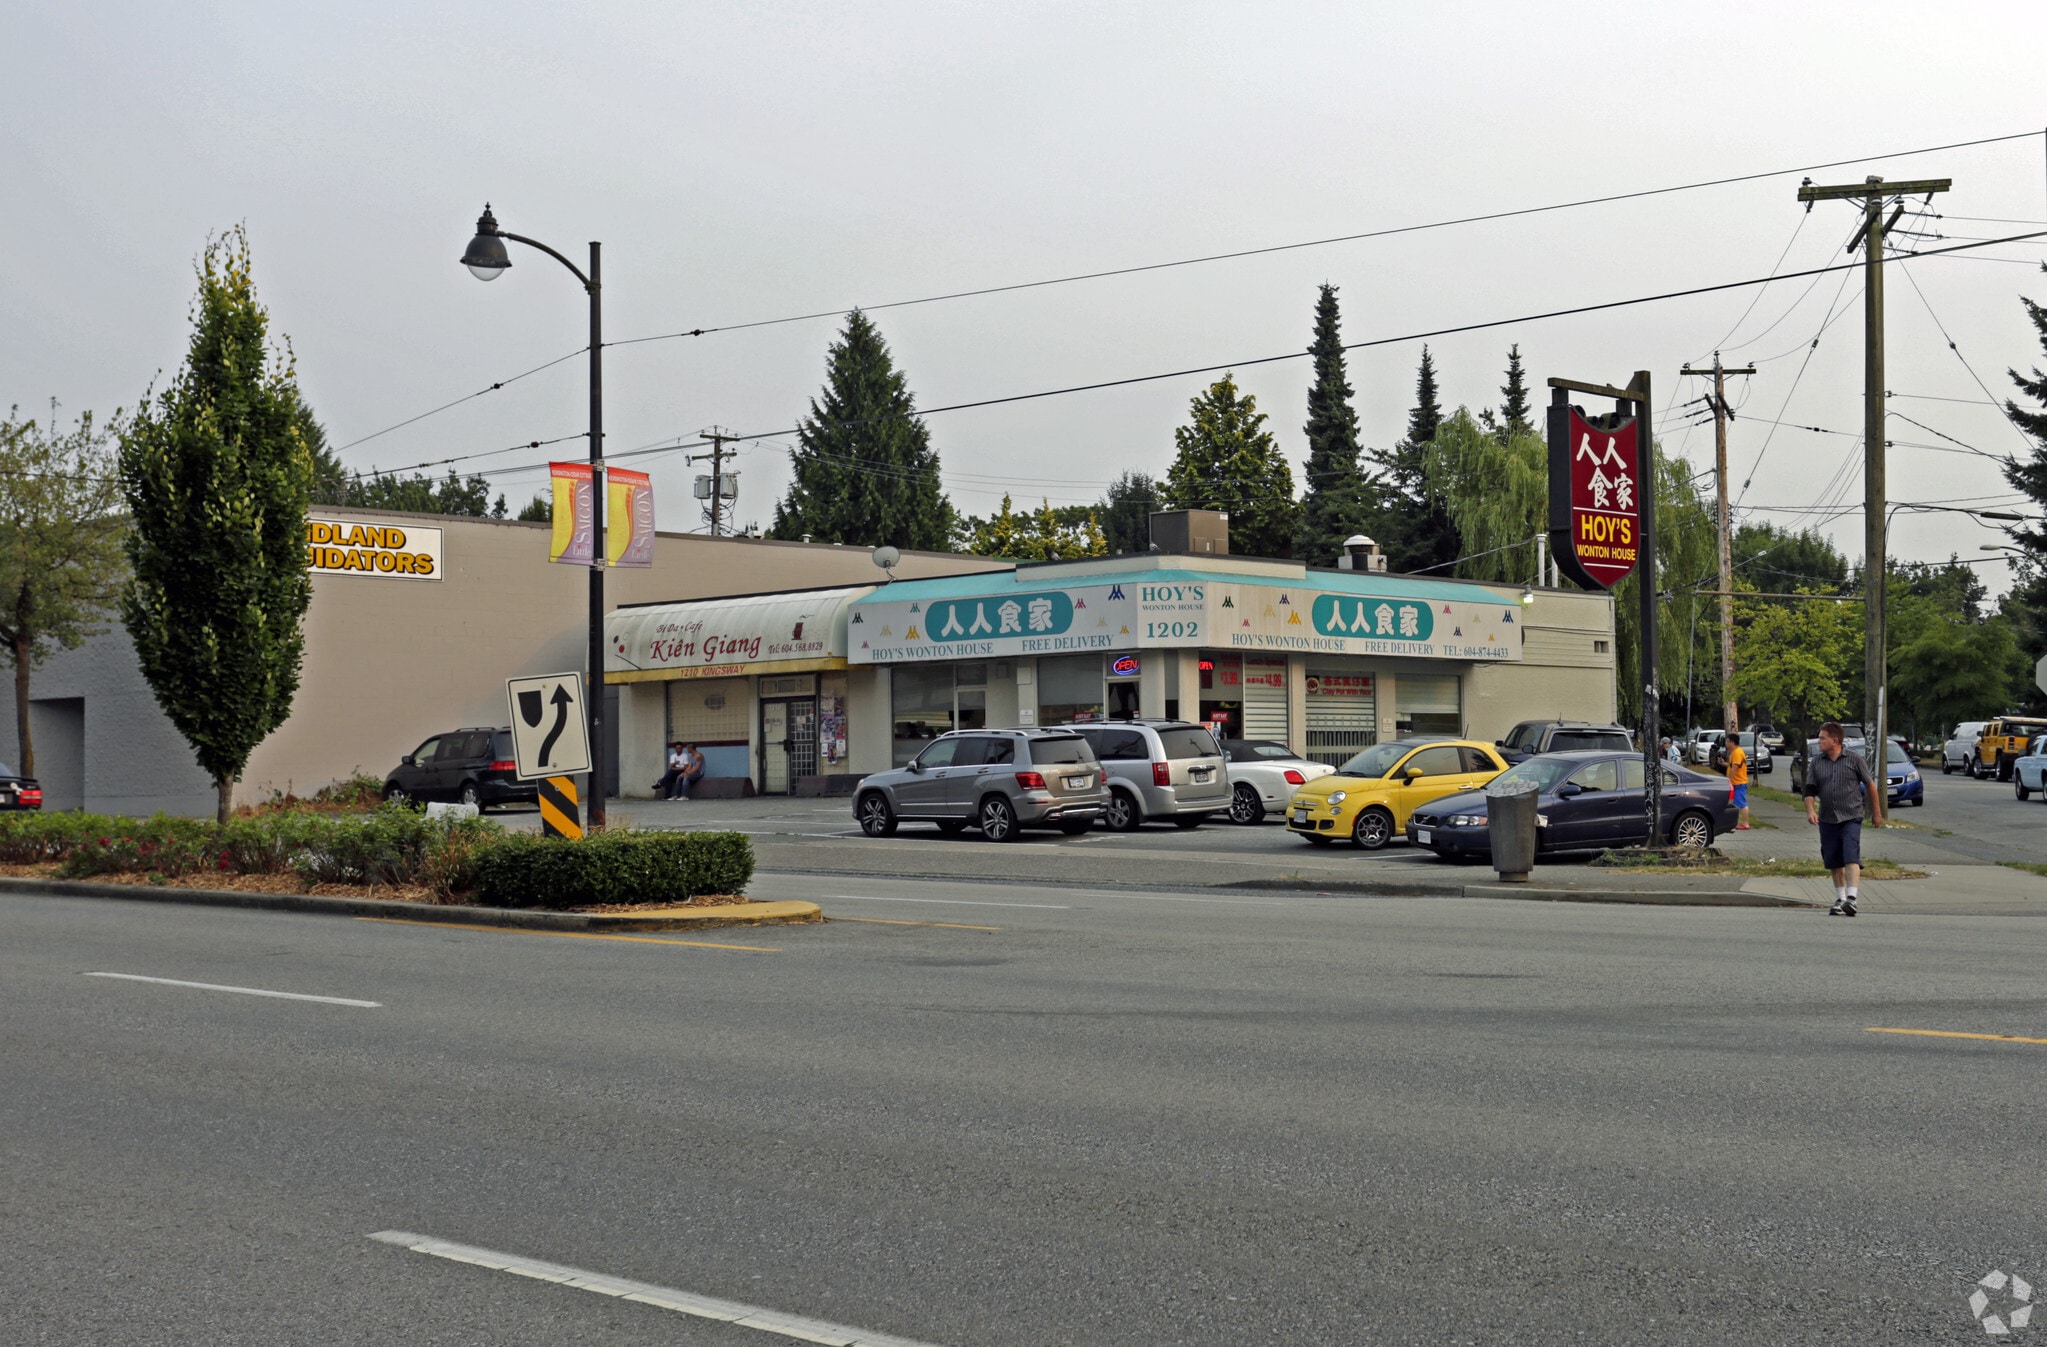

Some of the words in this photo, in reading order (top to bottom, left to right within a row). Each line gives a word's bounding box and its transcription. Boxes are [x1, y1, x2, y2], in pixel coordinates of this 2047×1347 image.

[1576, 432, 1627, 470] 人人
[1588, 466, 1634, 511] 食家
[576, 481, 591, 545] SAIGON
[1581, 514, 1631, 544] HOY'S
[1576, 544, 1610, 559] WONTON
[1611, 549, 1636, 561] HOUSE
[1142, 586, 1204, 602] HOY'S
[940, 597, 1053, 638] 人人食家
[1326, 599, 1419, 637] 人人食家
[1147, 621, 1198, 639] 1202
[650, 636, 696, 662] Kiên
[703, 634, 762, 662] Giang
[872, 648, 904, 660] HOY'S
[906, 644, 953, 658] WONTON
[956, 642, 994, 656] HOUSE
[1022, 638, 1051, 652] FREE
[1054, 634, 1114, 650] DELIVERY
[1232, 633, 1264, 646] HOY'S
[1265, 635, 1311, 649] WONTON
[1313, 637, 1346, 651] HOUSE
[1365, 641, 1388, 653] FREE
[1390, 642, 1434, 655] DELIVERY
[1443, 645, 1462, 656] TEL:
[1463, 646, 1509, 658] 604-874-4433
[681, 668, 699, 677] 1210
[702, 665, 746, 677] KINGSWAY
[1116, 660, 1138, 671] OPEN
[1199, 661, 1213, 670] OPEN
